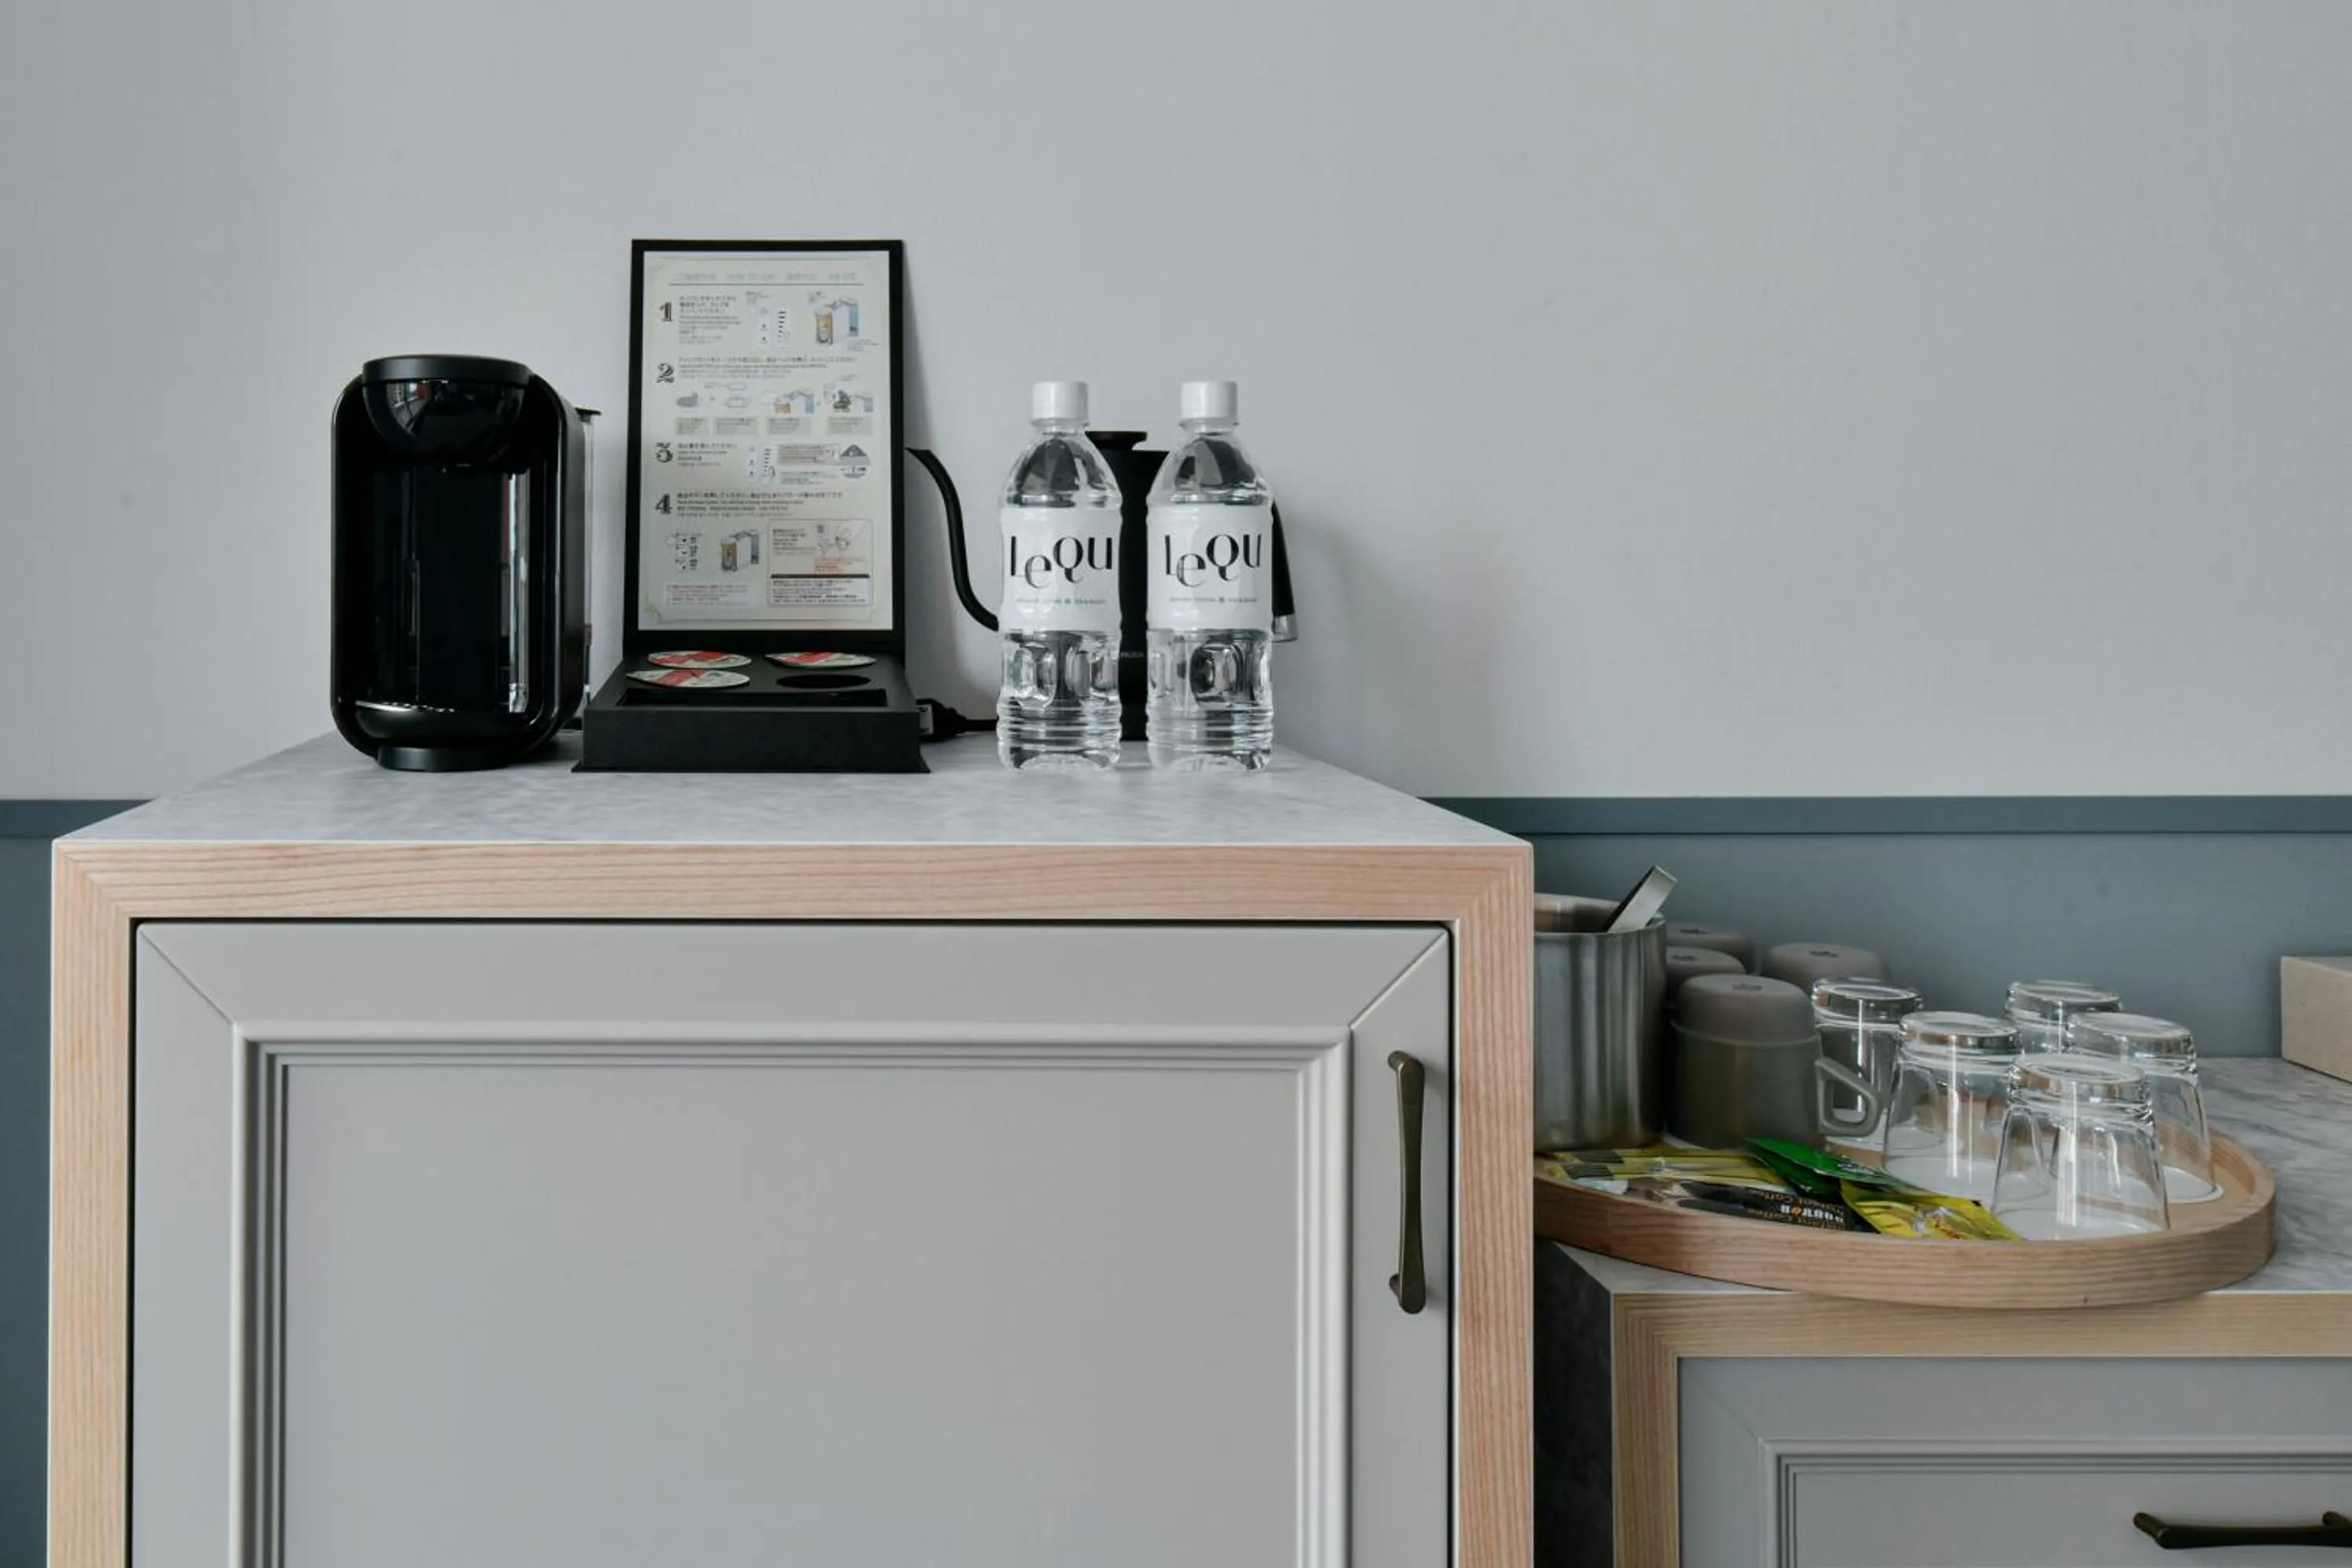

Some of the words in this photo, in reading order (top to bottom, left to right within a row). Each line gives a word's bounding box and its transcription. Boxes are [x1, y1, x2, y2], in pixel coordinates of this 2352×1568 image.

[659, 302, 673, 321] 1
[657, 363, 674, 383] 2
[656, 441, 673, 463] 3
[655, 493, 672, 514] 4
